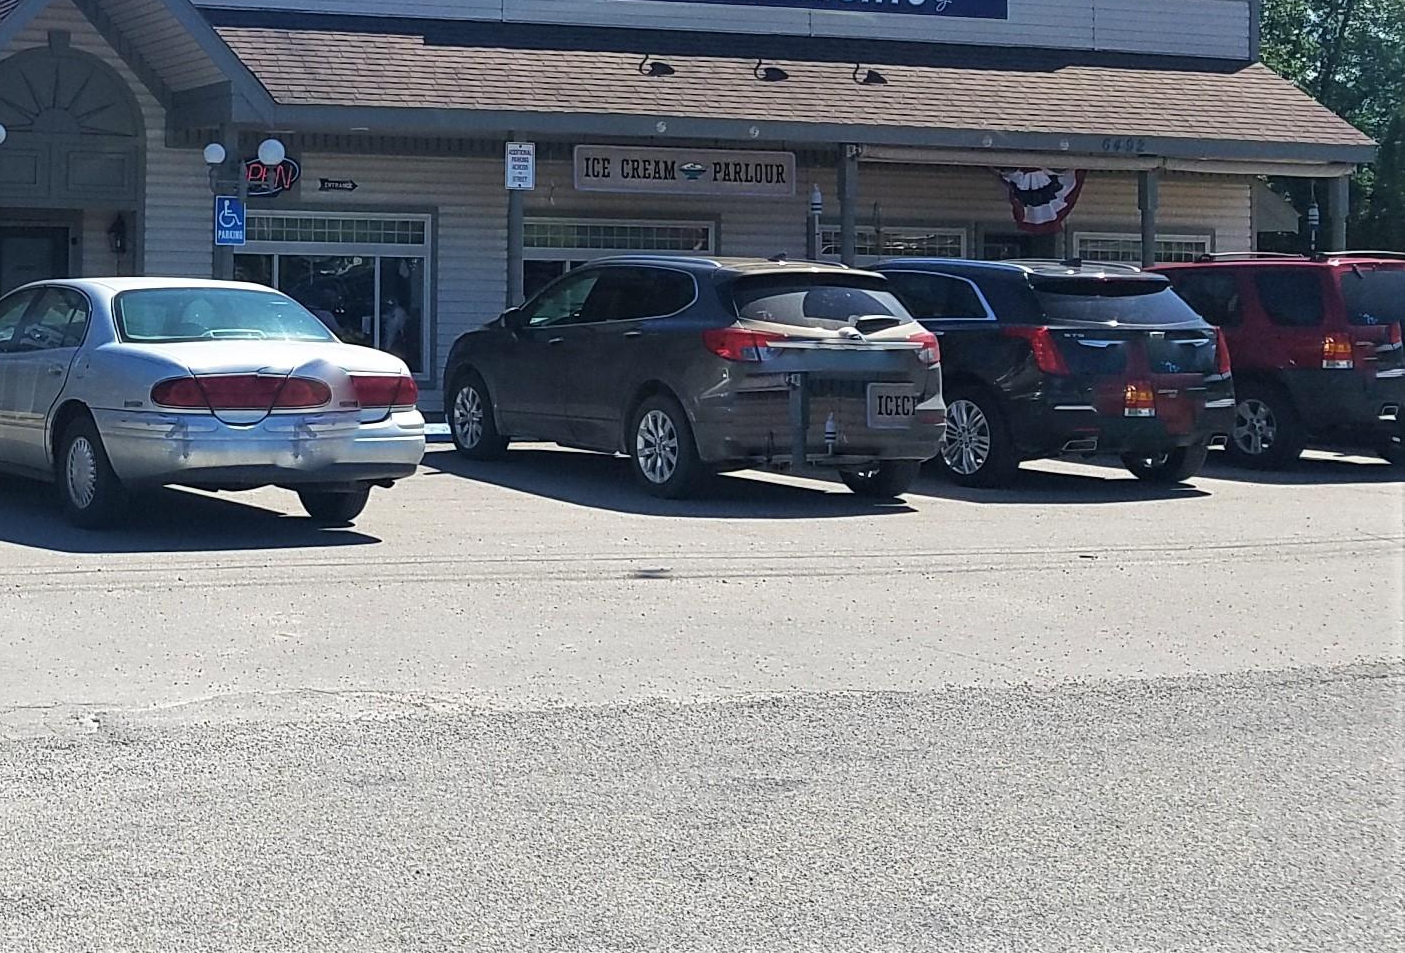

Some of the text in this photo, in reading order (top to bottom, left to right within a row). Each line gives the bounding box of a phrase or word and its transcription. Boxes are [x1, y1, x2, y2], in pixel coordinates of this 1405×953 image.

[583, 157, 786, 184] ICE CREAM PARLOUR
[218, 229, 243, 240] PARKING
